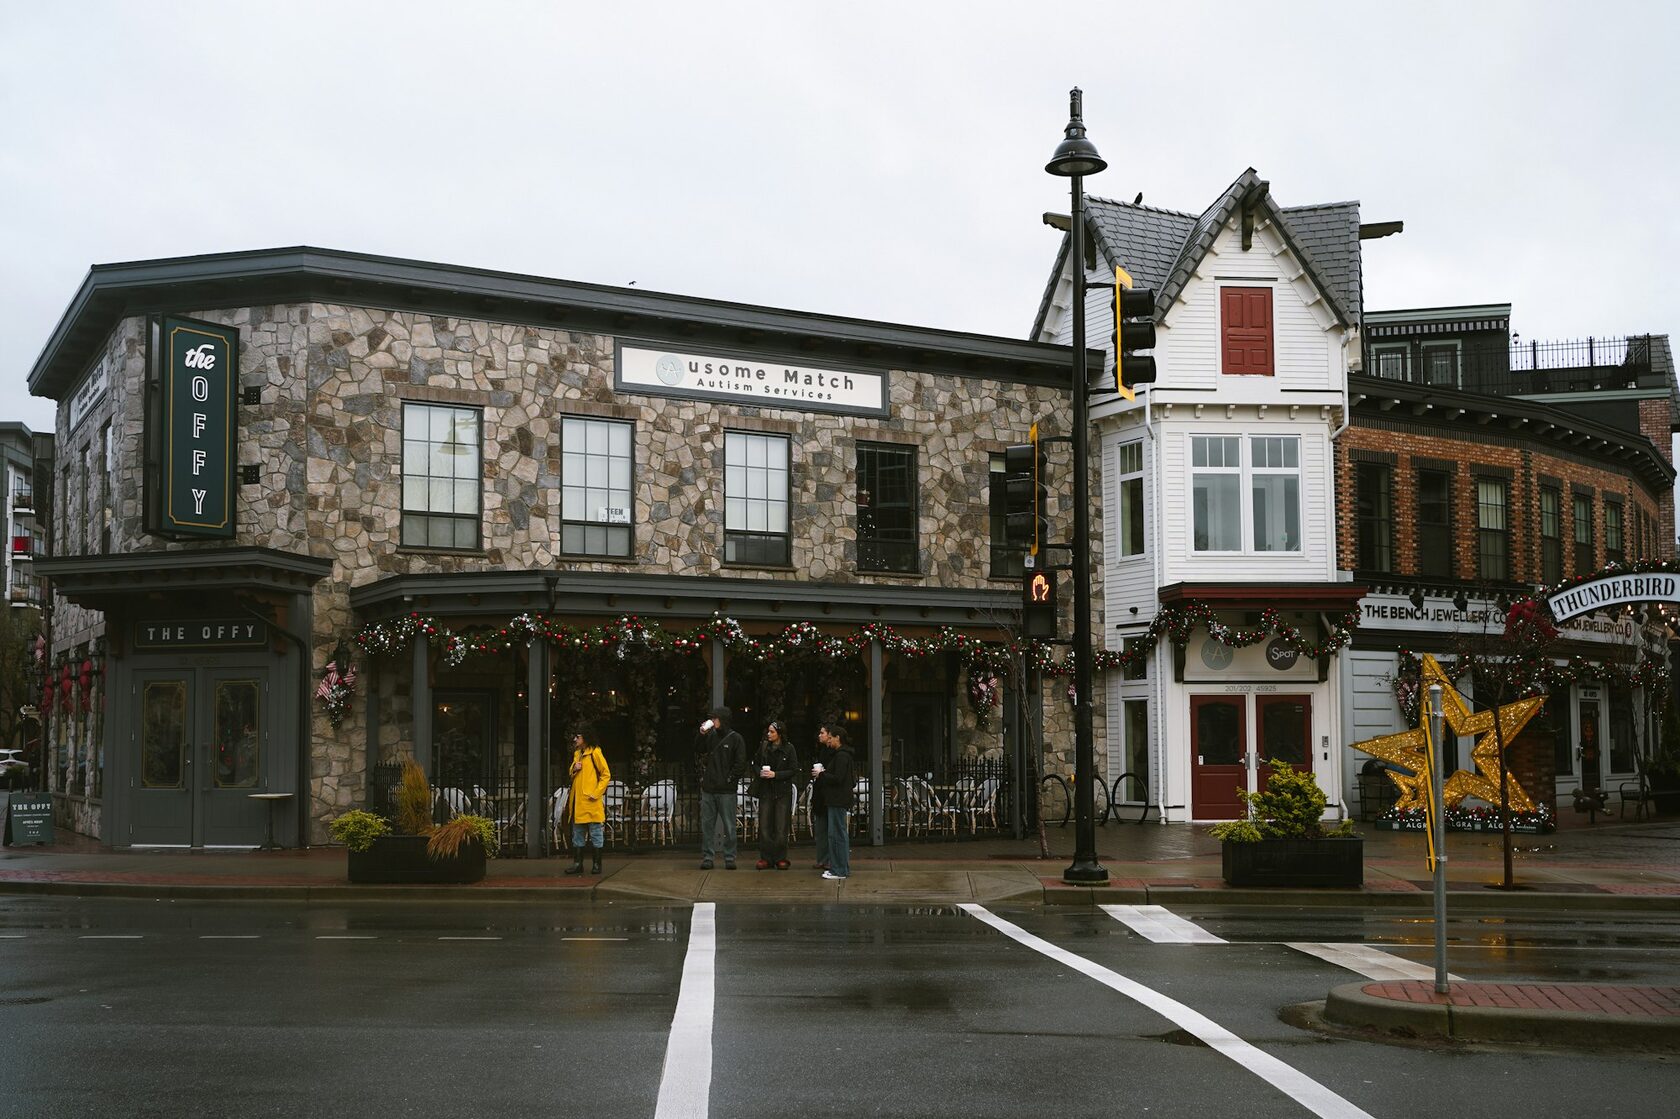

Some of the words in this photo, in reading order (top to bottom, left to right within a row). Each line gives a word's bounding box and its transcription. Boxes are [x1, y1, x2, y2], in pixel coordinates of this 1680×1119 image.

[184, 343, 216, 370] the
[688, 361, 766, 380] usome
[784, 369, 854, 390] Match
[696, 378, 753, 391] Autism
[764, 385, 832, 400] Services
[191, 376, 209, 515] OFFY
[1553, 577, 1676, 616] THUNDERBIRD
[1364, 604, 1389, 618] THE
[1390, 606, 1429, 621] BENCH
[1431, 608, 1492, 623] JEWELLERY
[147, 627, 185, 641] THE
[202, 625, 254, 639] OFFY
